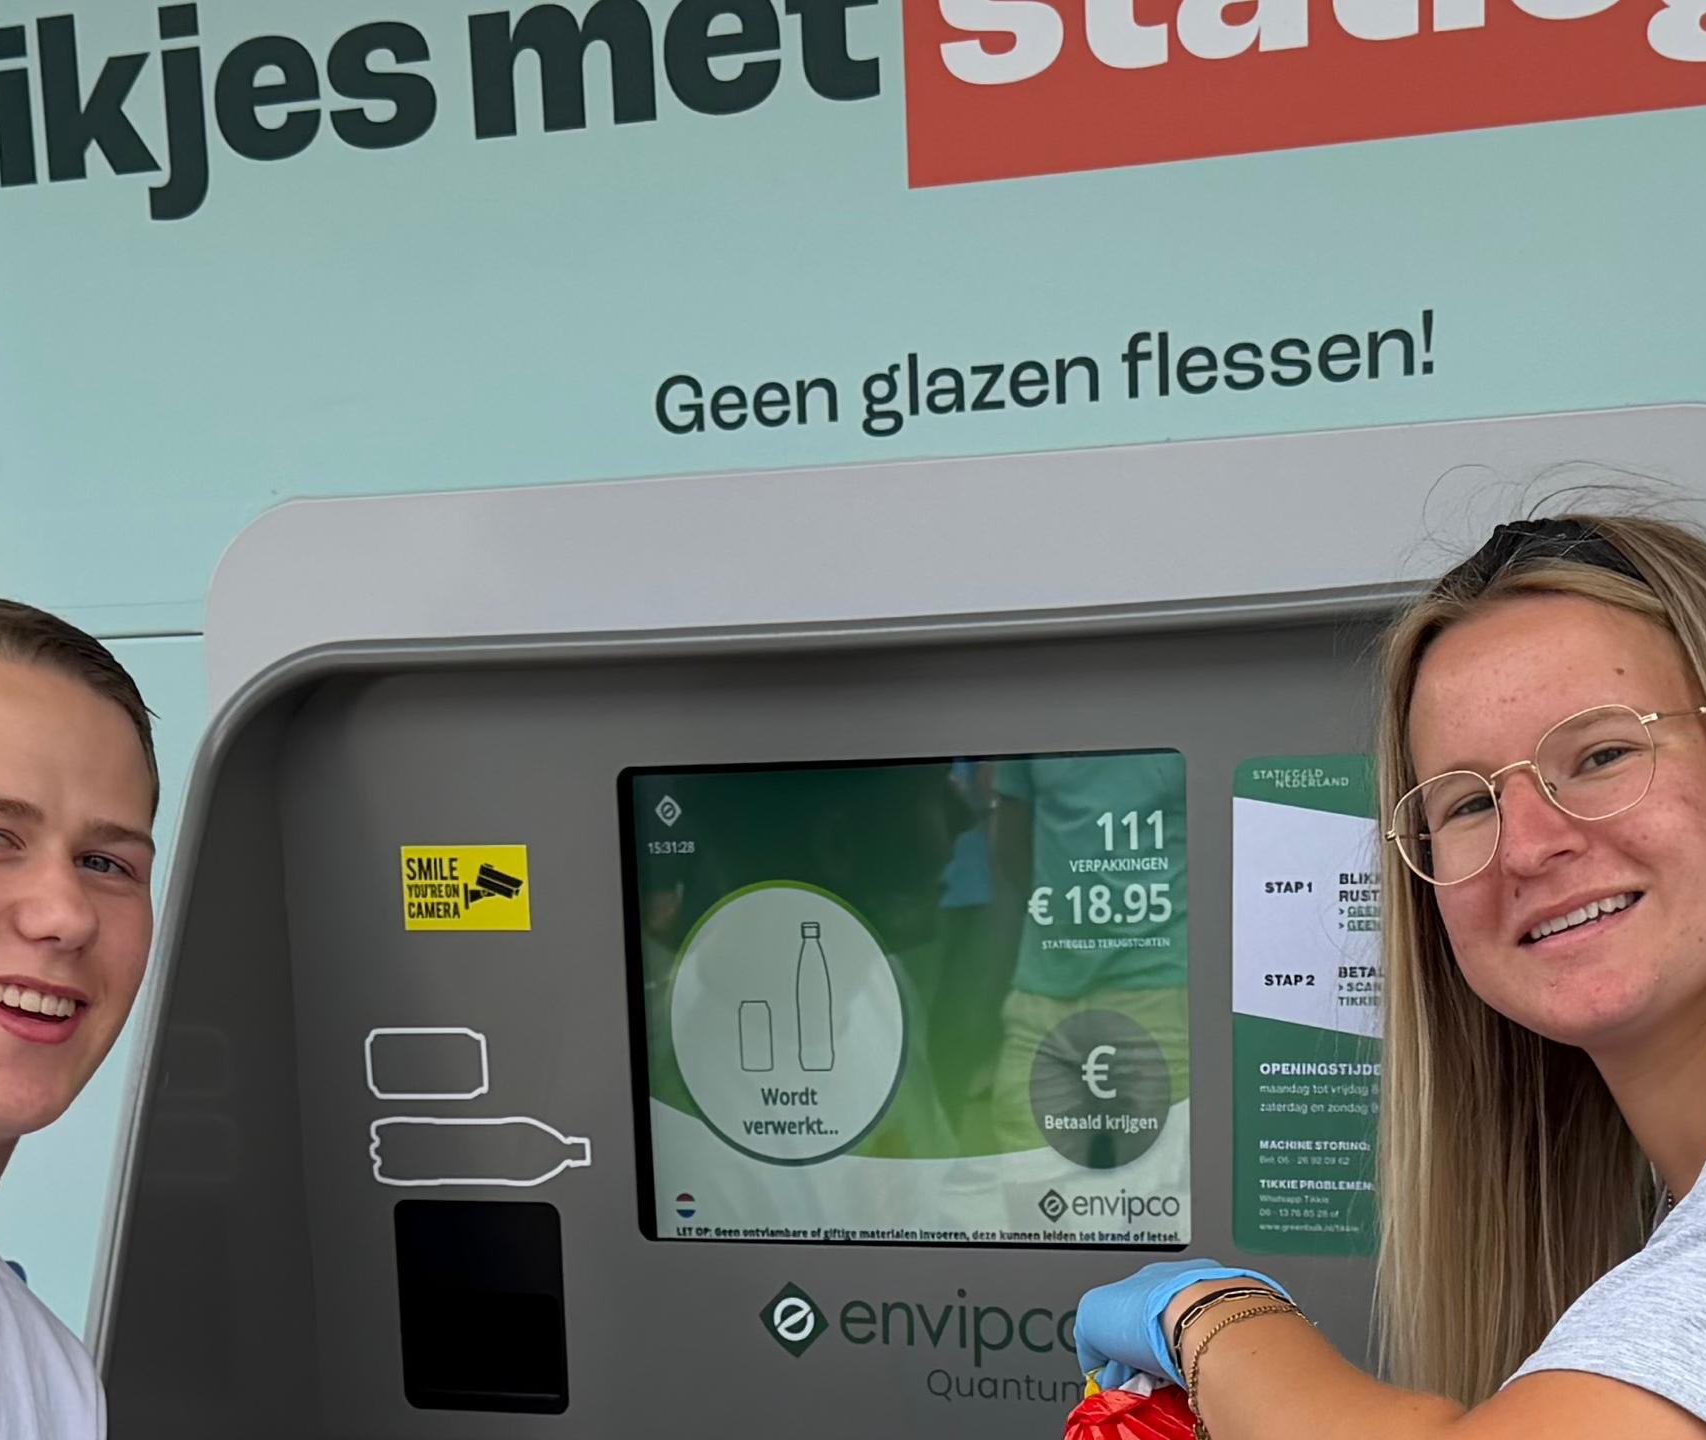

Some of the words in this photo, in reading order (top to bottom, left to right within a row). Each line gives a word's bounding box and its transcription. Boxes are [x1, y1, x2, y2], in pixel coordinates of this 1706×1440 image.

[468, 0, 881, 141] met
[656, 373, 839, 435] Geen
[861, 351, 1100, 437] glazen
[1121, 308, 1436, 400] flessen!
[1253, 769, 1324, 781] STATIEGELD
[1275, 777, 1349, 789] NEDERLAND
[1096, 810, 1164, 851] 111
[406, 857, 459, 881] SMILE
[1069, 857, 1169, 873] VERPAKKINGEN
[407, 884, 443, 898] YOU'RE
[445, 884, 460, 898] ON
[1265, 882, 1305, 893] STAP
[1307, 882, 1313, 893] 1
[407, 902, 461, 919] CAMERA
[1028, 886, 1054, 926] €
[1065, 883, 1173, 924] 18.95
[1042, 938, 1096, 949] STATIEGELD
[1098, 936, 1170, 948] TERUGSTORTEN
[1264, 975, 1304, 986] STAP
[1306, 975, 1315, 986] 2
[760, 1087, 818, 1106] Wordt
[1260, 1084, 1310, 1096] maandag
[1313, 1084, 1329, 1094] tot
[1260, 1102, 1308, 1114] zaterdag
[1310, 1103, 1325, 1112] en
[743, 1116, 839, 1135] verwerkt...
[1044, 1115, 1101, 1130] Betaald
[1106, 1115, 1158, 1134] krijgen
[1260, 1140, 1313, 1150] MACHINE
[1259, 1180, 1299, 1189] TIKKIE
[1072, 1188, 1181, 1224] envipco
[714, 1227, 741, 1238] Geen
[810, 1228, 822, 1238] of
[971, 1230, 997, 1240] deze
[998, 1230, 1041, 1241] kunnen
[1079, 1231, 1096, 1241] tot
[1098, 1230, 1131, 1242] brand
[1133, 1231, 1146, 1242] of
